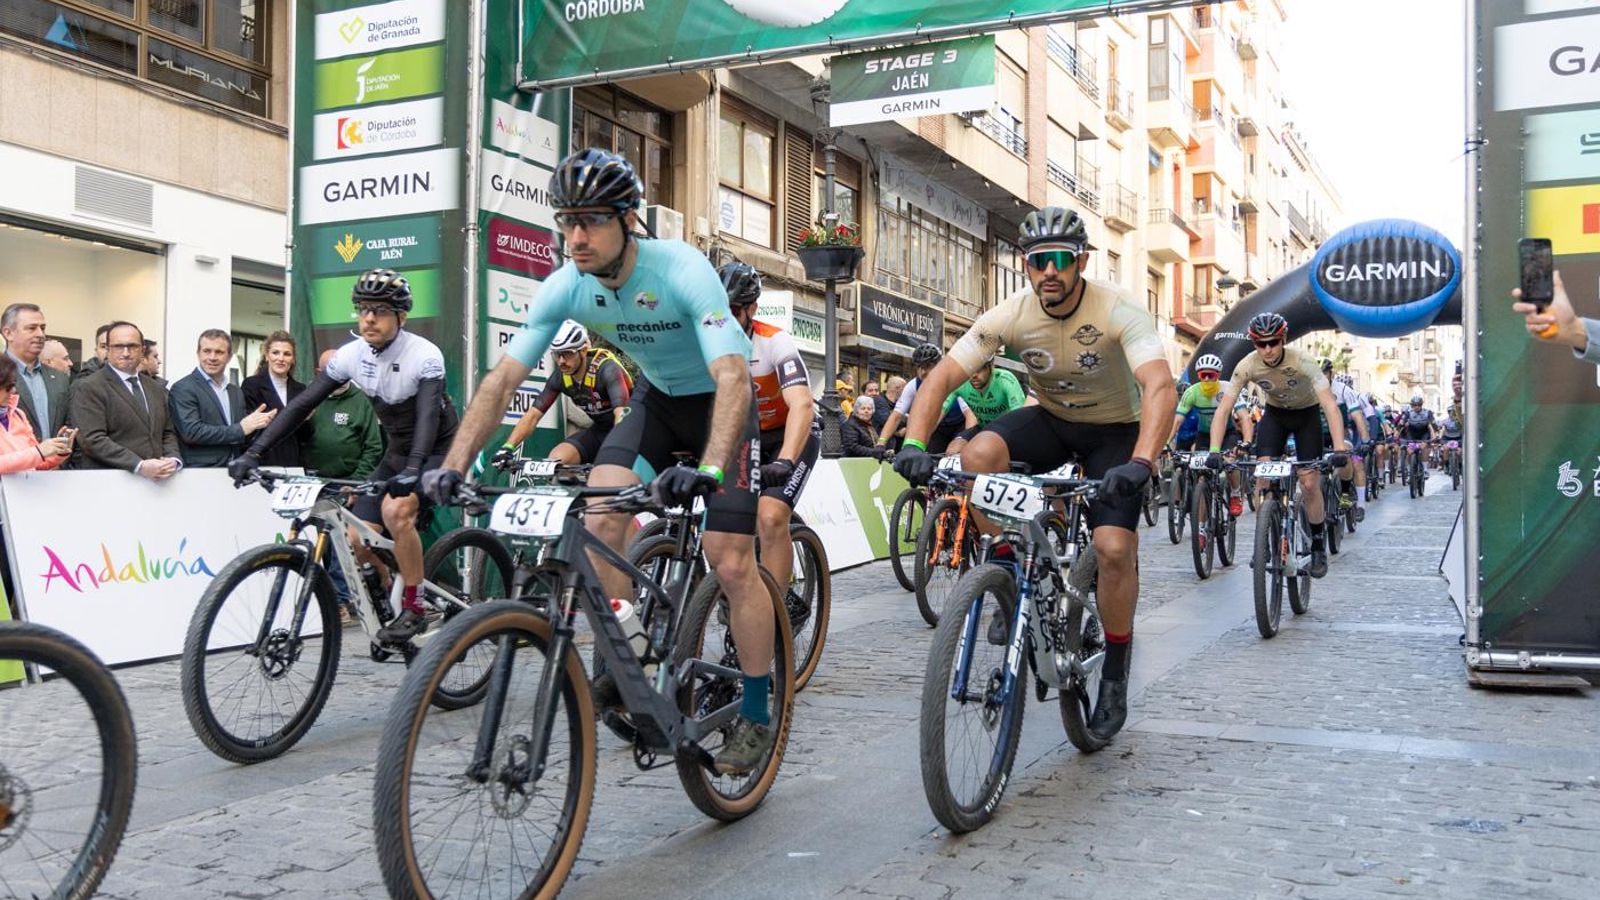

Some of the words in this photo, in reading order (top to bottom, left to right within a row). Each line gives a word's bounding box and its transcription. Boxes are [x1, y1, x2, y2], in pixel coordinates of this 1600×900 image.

[367, 15, 418, 31] Diputación
[367, 33, 379, 42] de
[381, 26, 421, 40] Granada
[864, 52, 936, 74] STAGE
[941, 49, 958, 63] 3
[150, 53, 262, 101] MURIANA
[891, 71, 929, 91] JAÉN
[881, 98, 941, 115] GARMIN
[367, 116, 417, 131] Diputación
[324, 171, 430, 203] GARMIN
[366, 240, 387, 250] CAJA
[388, 236, 418, 249] RURAL
[510, 235, 553, 259] IMDECO
[381, 249, 403, 261] JAÉN
[873, 300, 910, 326] VERÓNICA
[916, 313, 934, 333] JESÚS
[618, 332, 655, 344] Rioja
[783, 461, 808, 498] SYMISUR
[1260, 465, 1284, 474] 57-1
[983, 479, 1028, 513] 57-2
[505, 497, 556, 528] 43-1
[40, 536, 216, 595] Andalucía
